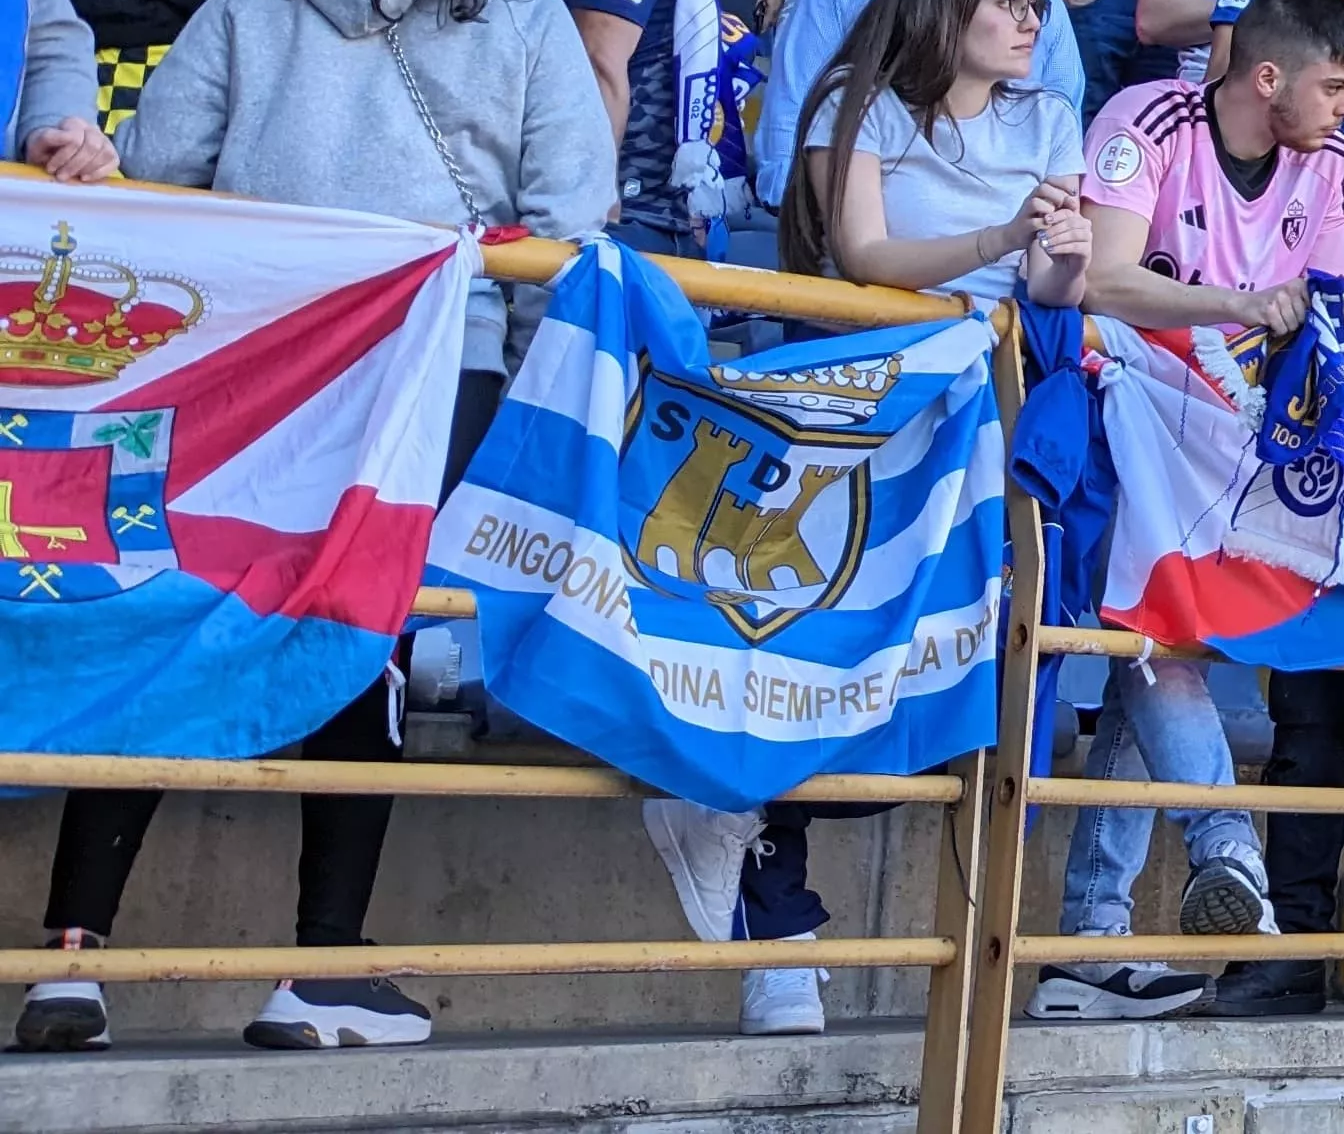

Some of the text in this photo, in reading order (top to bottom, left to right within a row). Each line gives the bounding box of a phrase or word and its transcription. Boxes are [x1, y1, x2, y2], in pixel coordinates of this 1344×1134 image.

[650, 400, 692, 443] S
[748, 457, 791, 493] D
[742, 668, 883, 723] SIEMPRE
